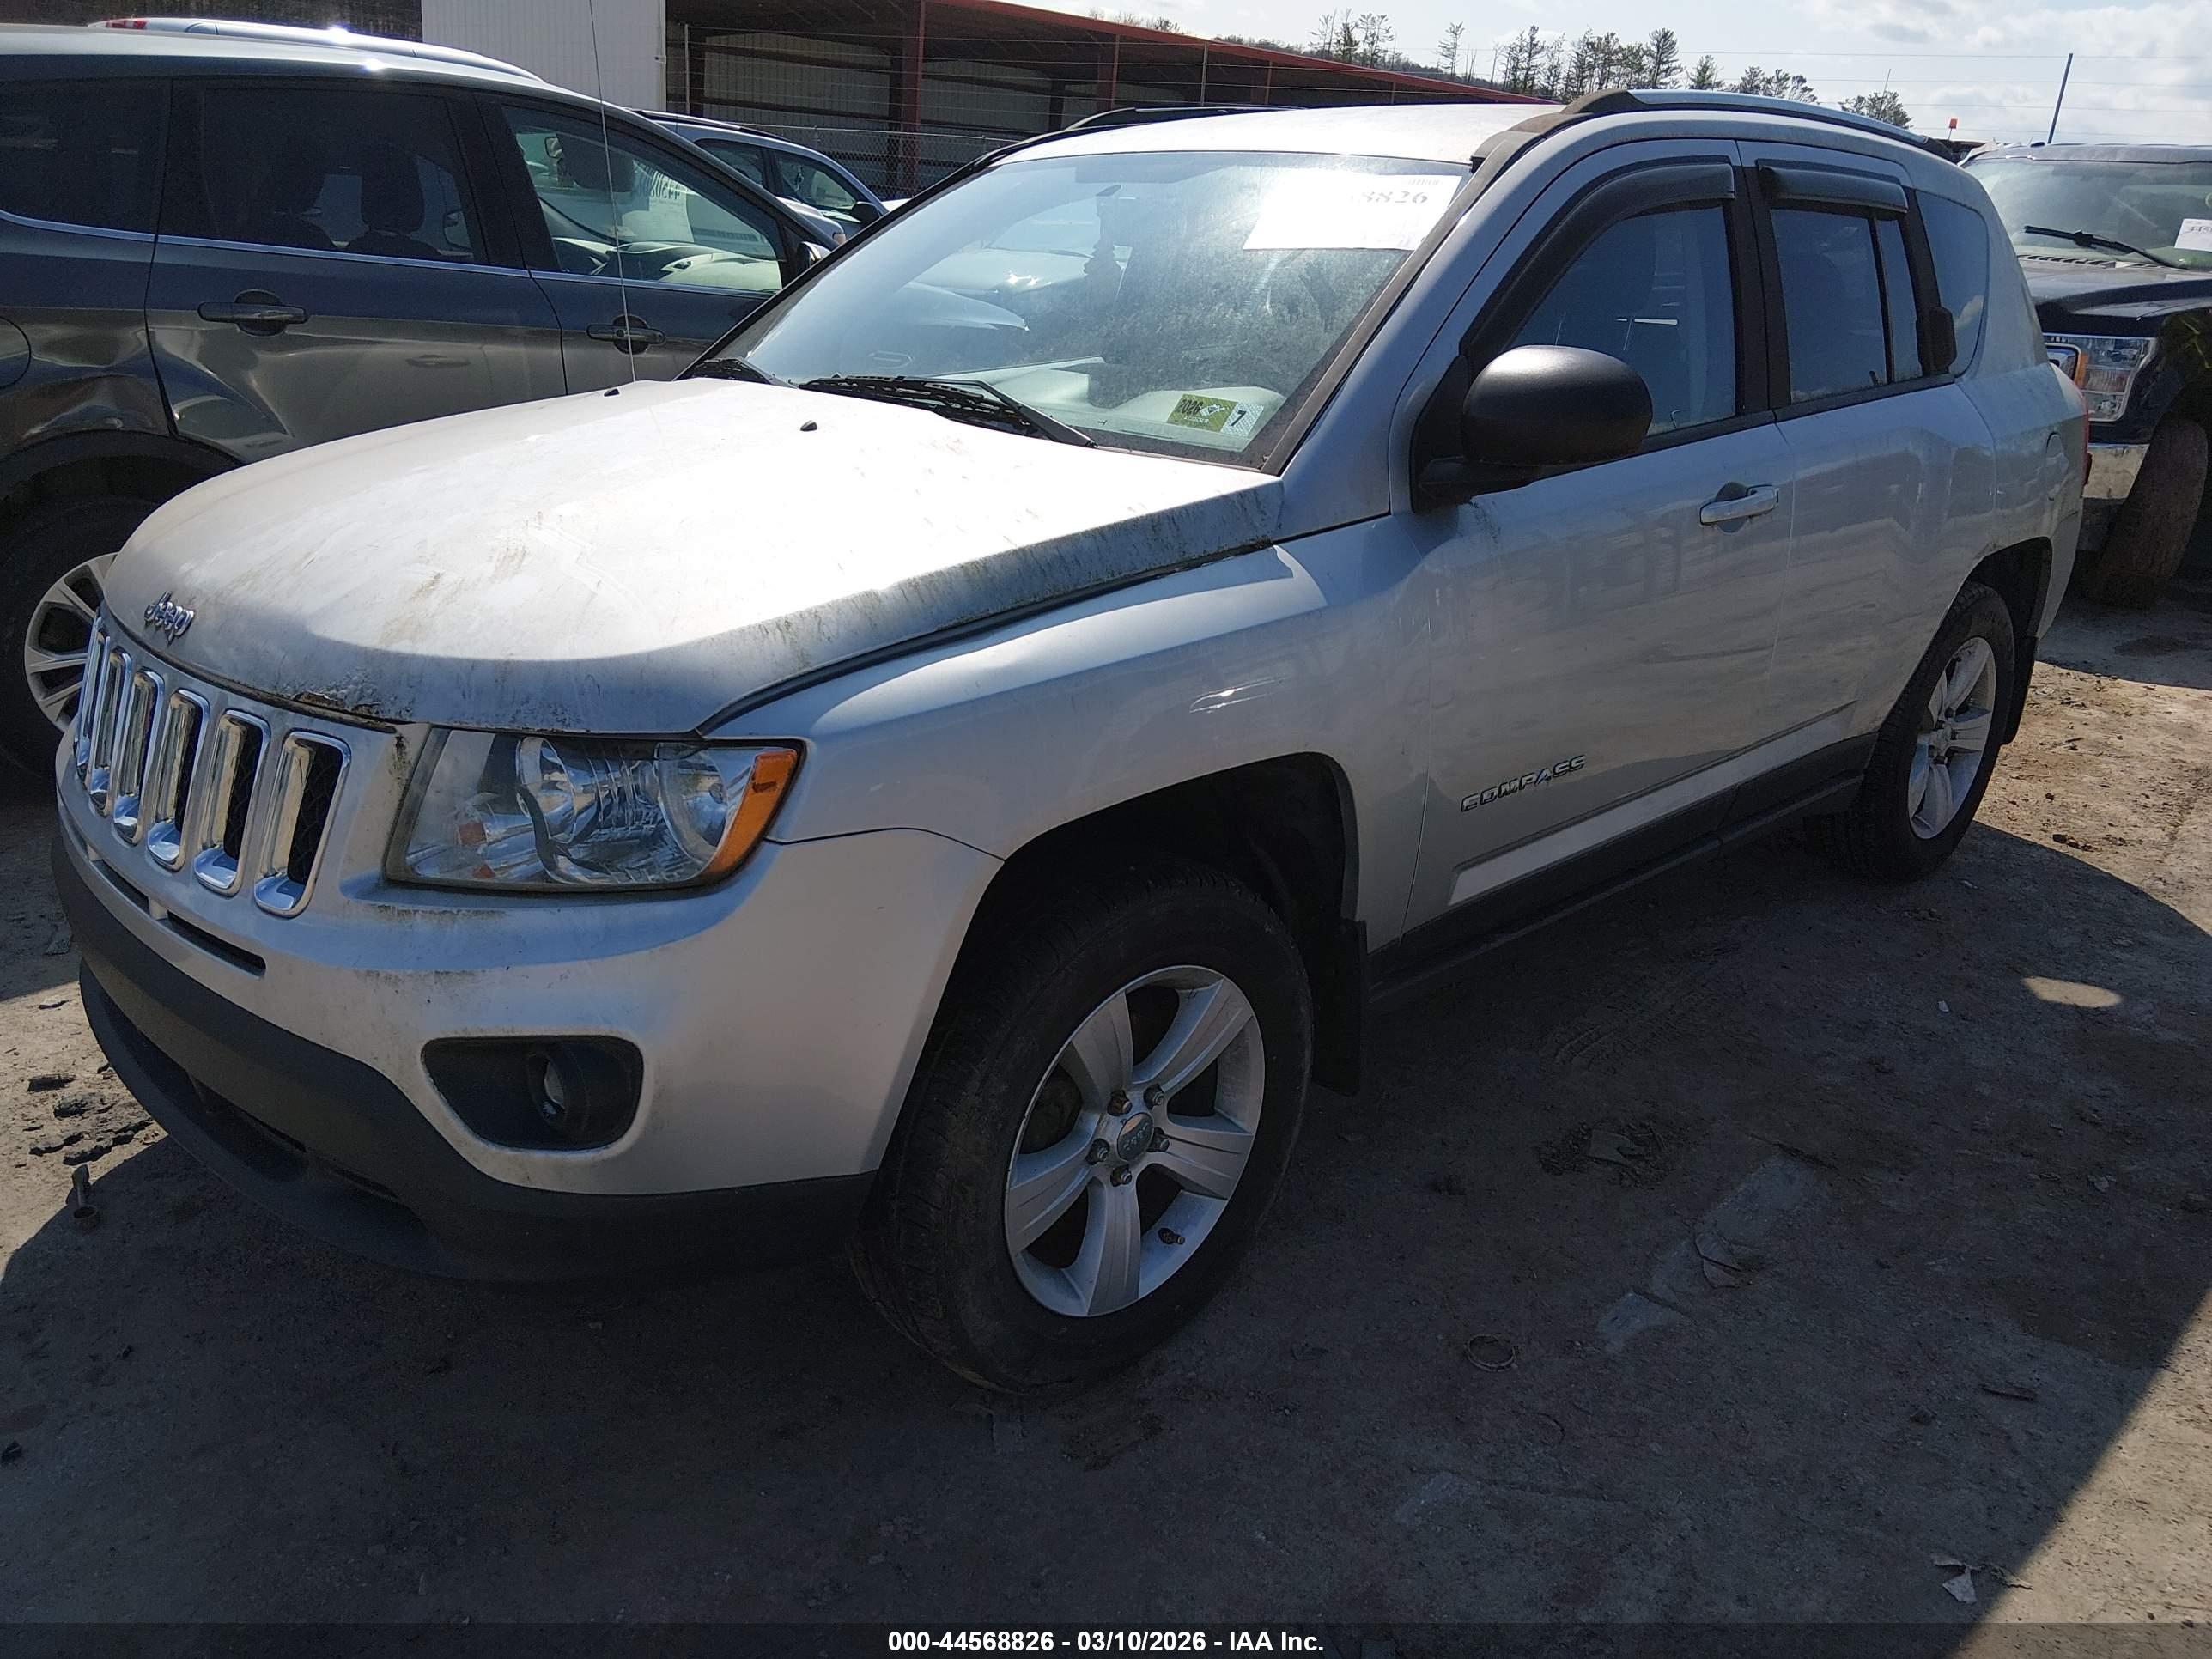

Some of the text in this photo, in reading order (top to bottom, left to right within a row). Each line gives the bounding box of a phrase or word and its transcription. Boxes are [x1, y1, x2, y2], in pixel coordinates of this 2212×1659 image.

[1176, 398, 1204, 416] 2026
[1230, 410, 1247, 427] 7
[144, 591, 195, 641] Jeep
[1461, 754, 1586, 812] COMPASS
